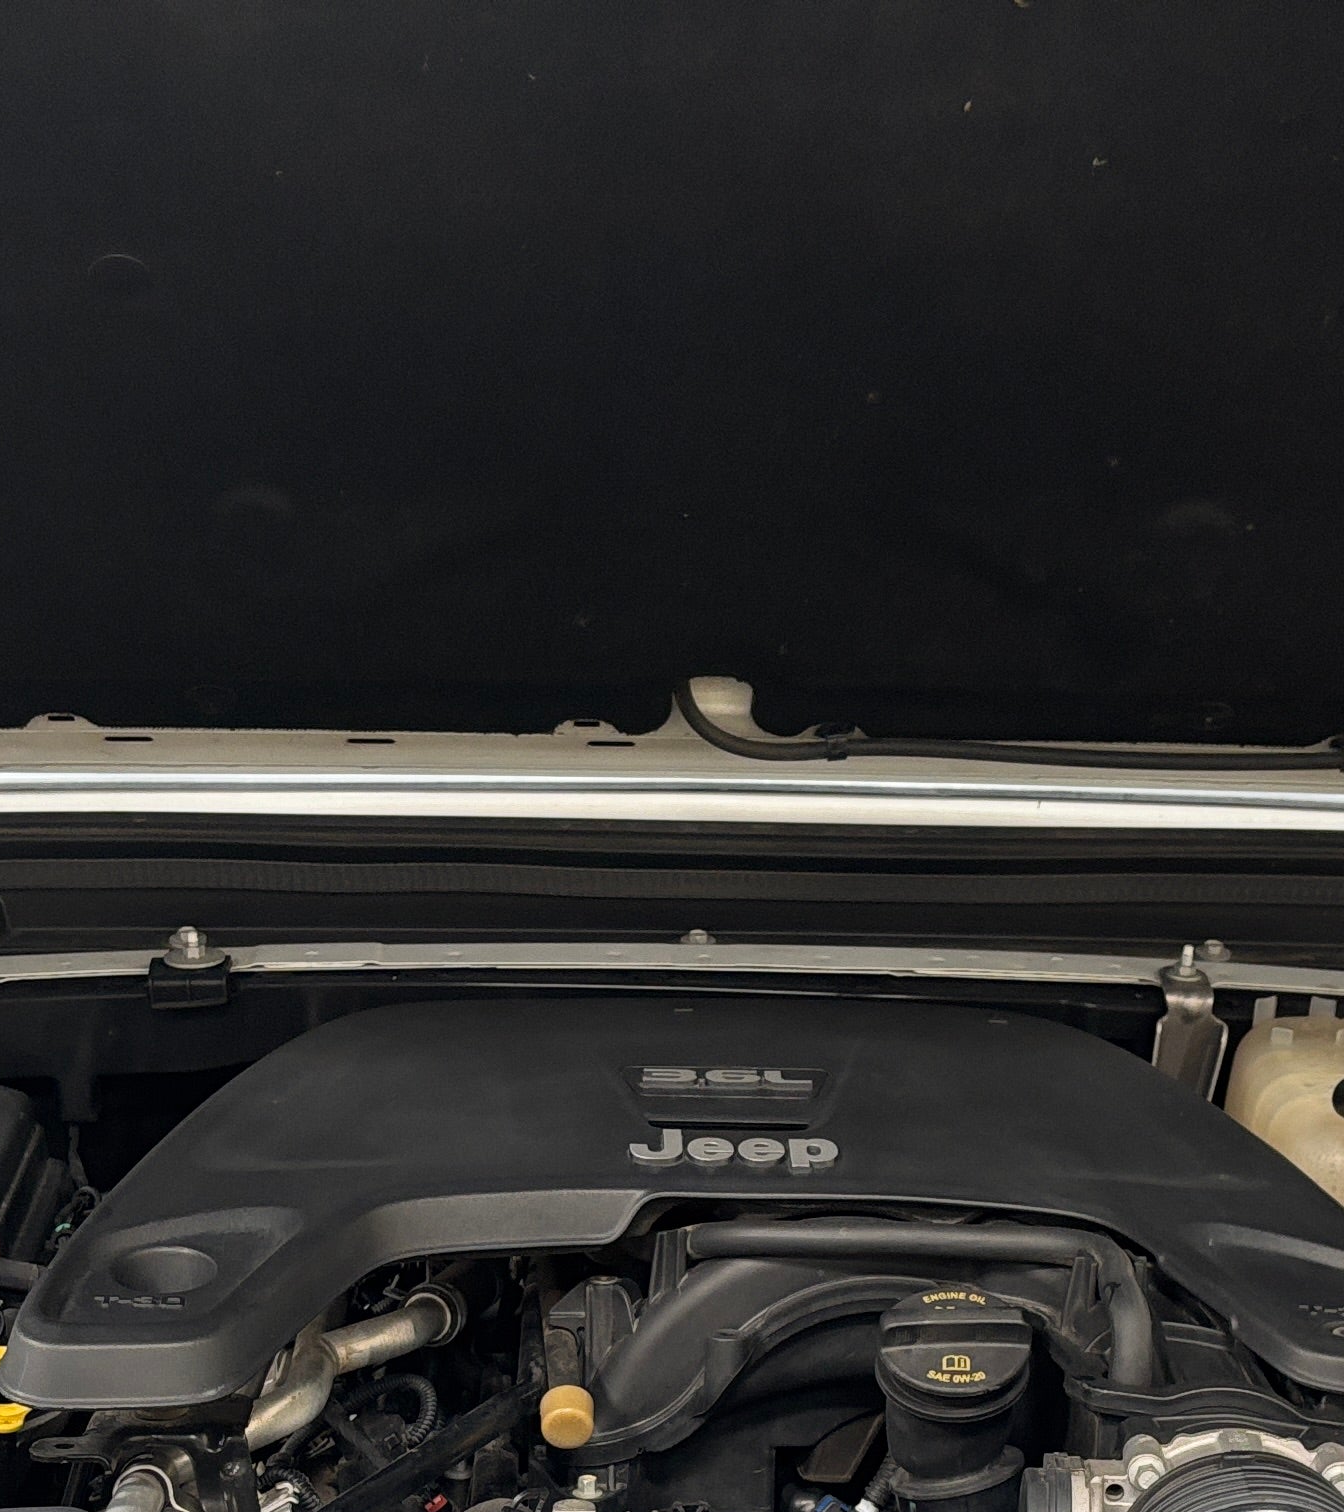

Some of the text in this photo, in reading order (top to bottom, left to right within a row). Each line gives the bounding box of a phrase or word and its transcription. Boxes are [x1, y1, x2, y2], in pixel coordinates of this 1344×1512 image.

[640, 1067, 813, 1091] 3.6L
[628, 1128, 840, 1172] Jeep
[922, 1291, 987, 1306] ENGINE OIL
[926, 1369, 987, 1384] SAE 0W-20
